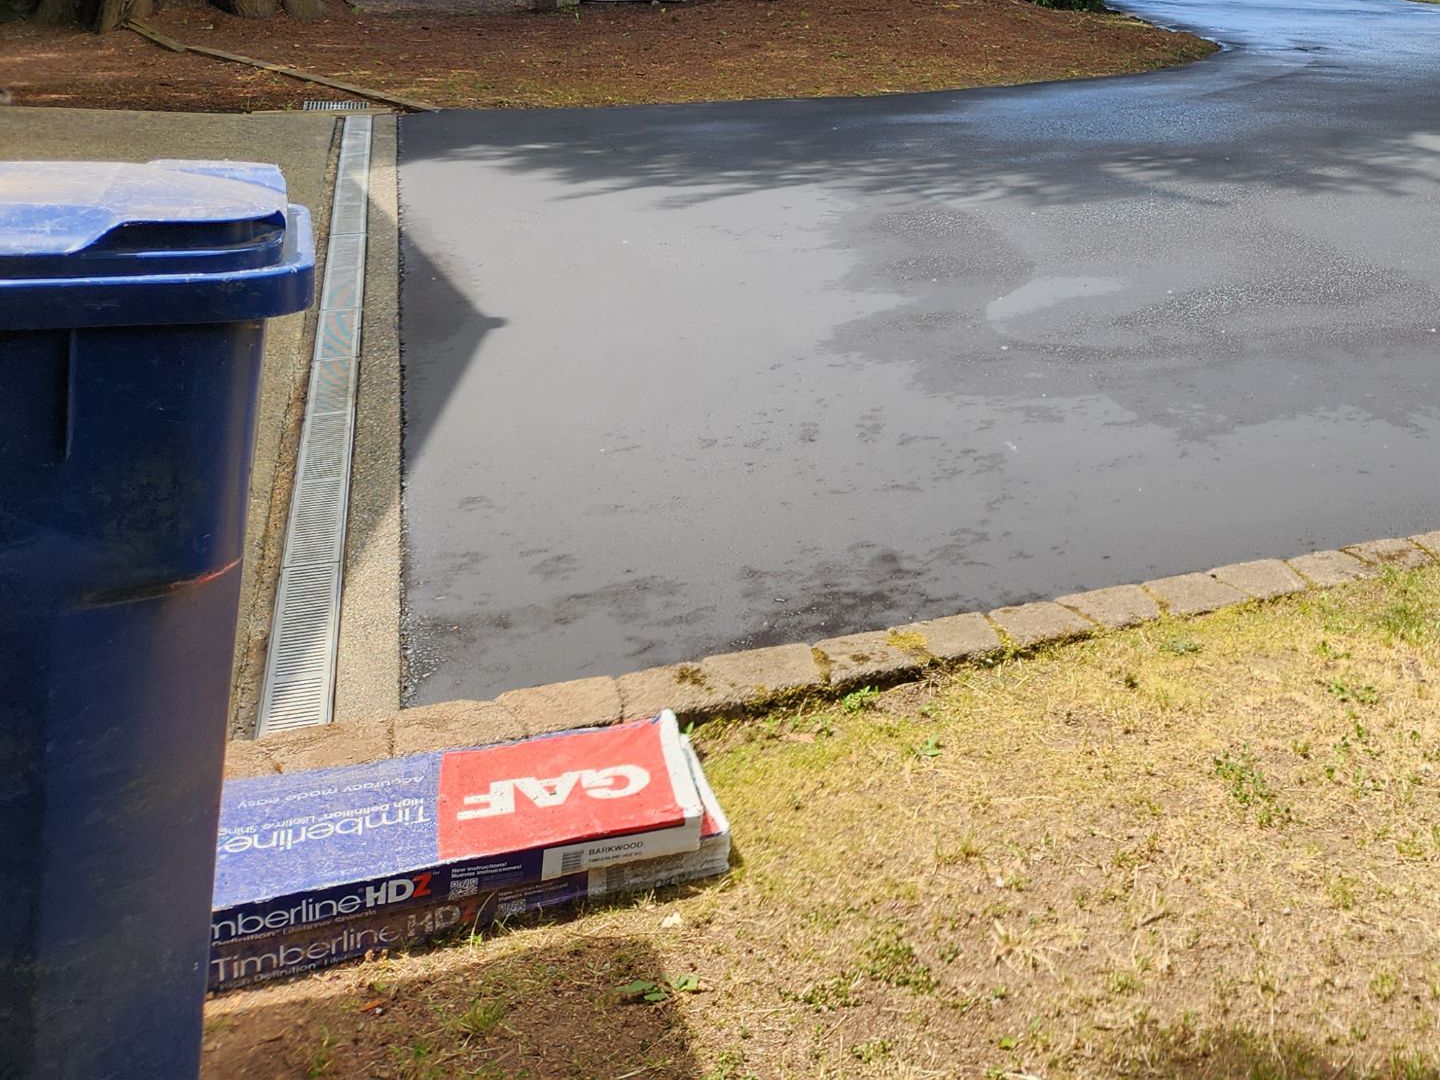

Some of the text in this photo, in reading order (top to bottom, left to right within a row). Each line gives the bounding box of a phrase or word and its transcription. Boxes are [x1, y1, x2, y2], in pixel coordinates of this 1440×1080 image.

[237, 774, 425, 811] Accuracy made easy
[325, 802, 391, 820] Definition
[393, 796, 425, 809] High
[456, 764, 651, 822] GAF
[218, 825, 258, 836] Shing
[224, 805, 432, 853] Timberline
[588, 841, 644, 856] BARKWOOD
[211, 871, 433, 940] mberline HDZ
[211, 924, 401, 983] Timberline
